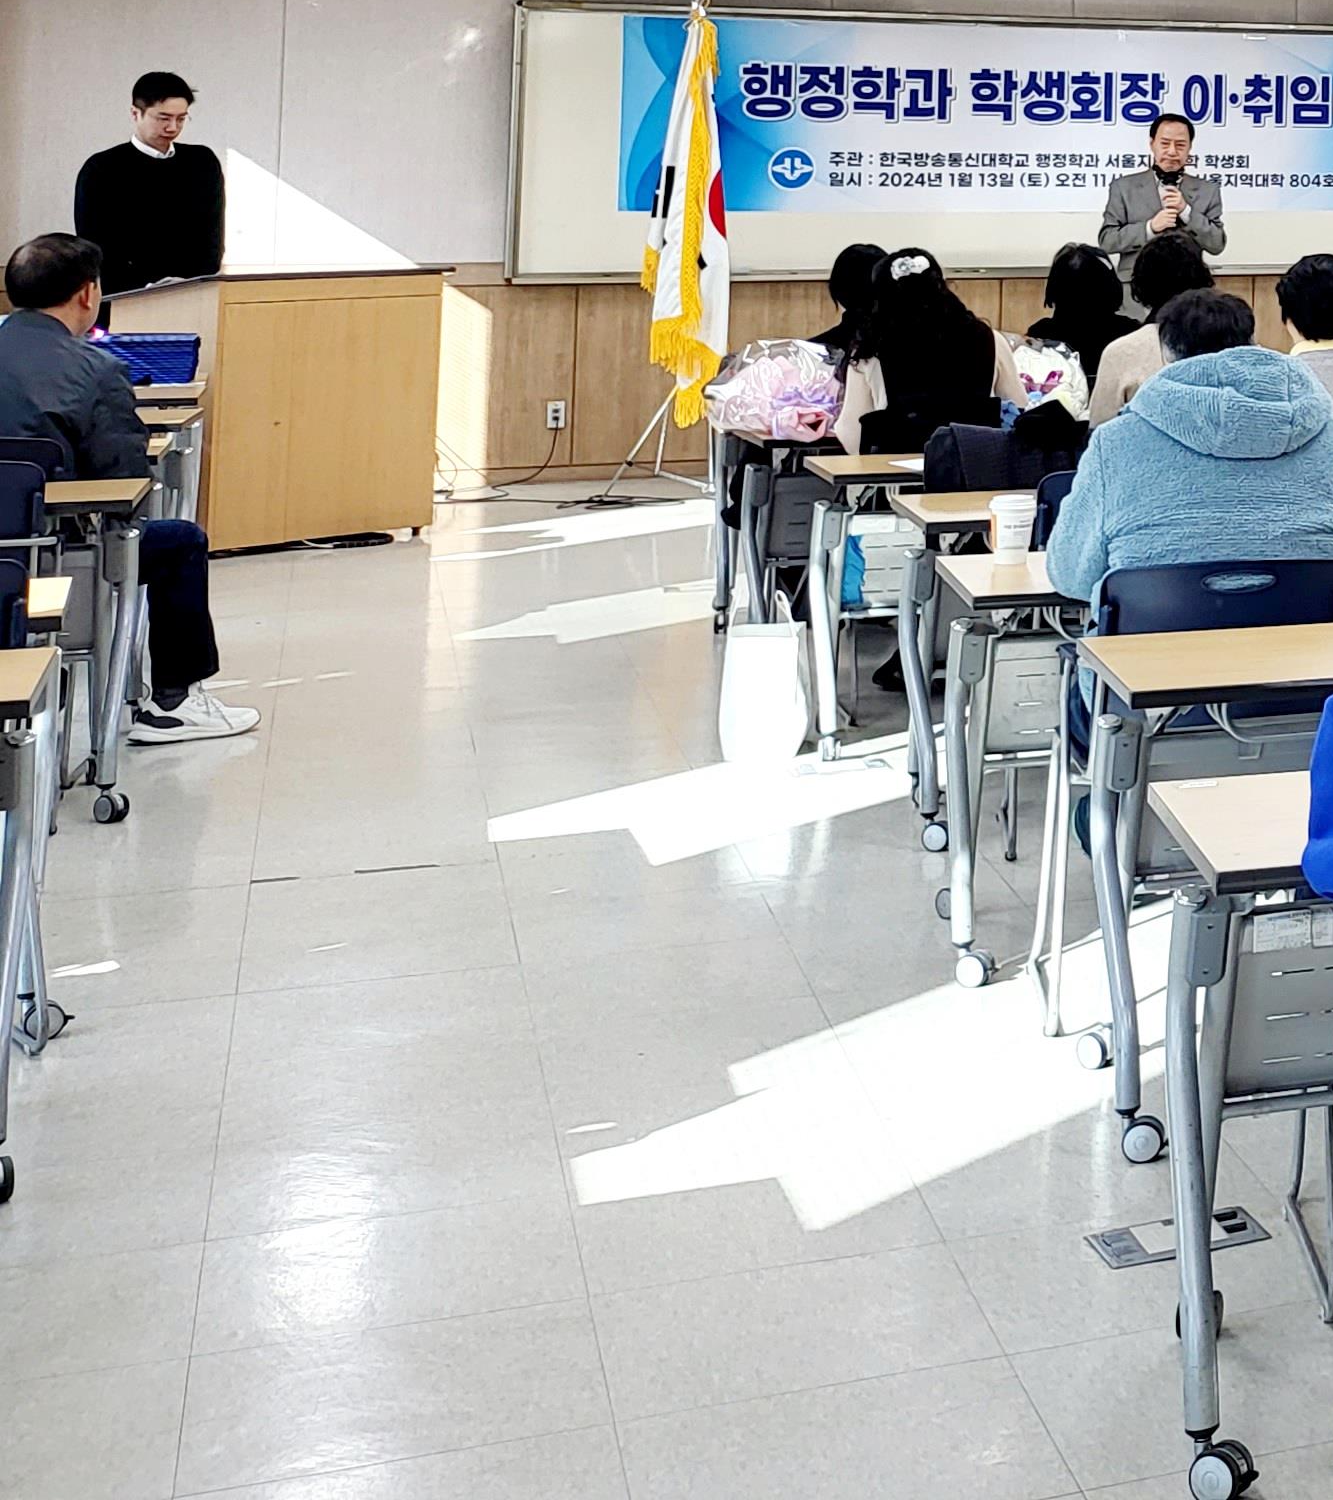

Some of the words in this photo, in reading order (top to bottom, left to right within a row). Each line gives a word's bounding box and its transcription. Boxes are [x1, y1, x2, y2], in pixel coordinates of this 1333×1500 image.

[740, 62, 956, 122] 행정학과
[968, 67, 1166, 124] 학생회장
[829, 152, 864, 168] 주관
[879, 152, 1029, 168] 한국방송통신대학교
[1035, 153, 1100, 169] 행정학과
[1105, 153, 1199, 169] 서울지학
[1204, 154, 1250, 169] 학생회
[828, 172, 862, 187] 일시
[878, 172, 943, 188] 2024년
[949, 172, 973, 188] 1월
[978, 172, 1014, 188] 13일
[1019, 173, 1050, 188] (토)
[1055, 173, 1086, 188] 오전
